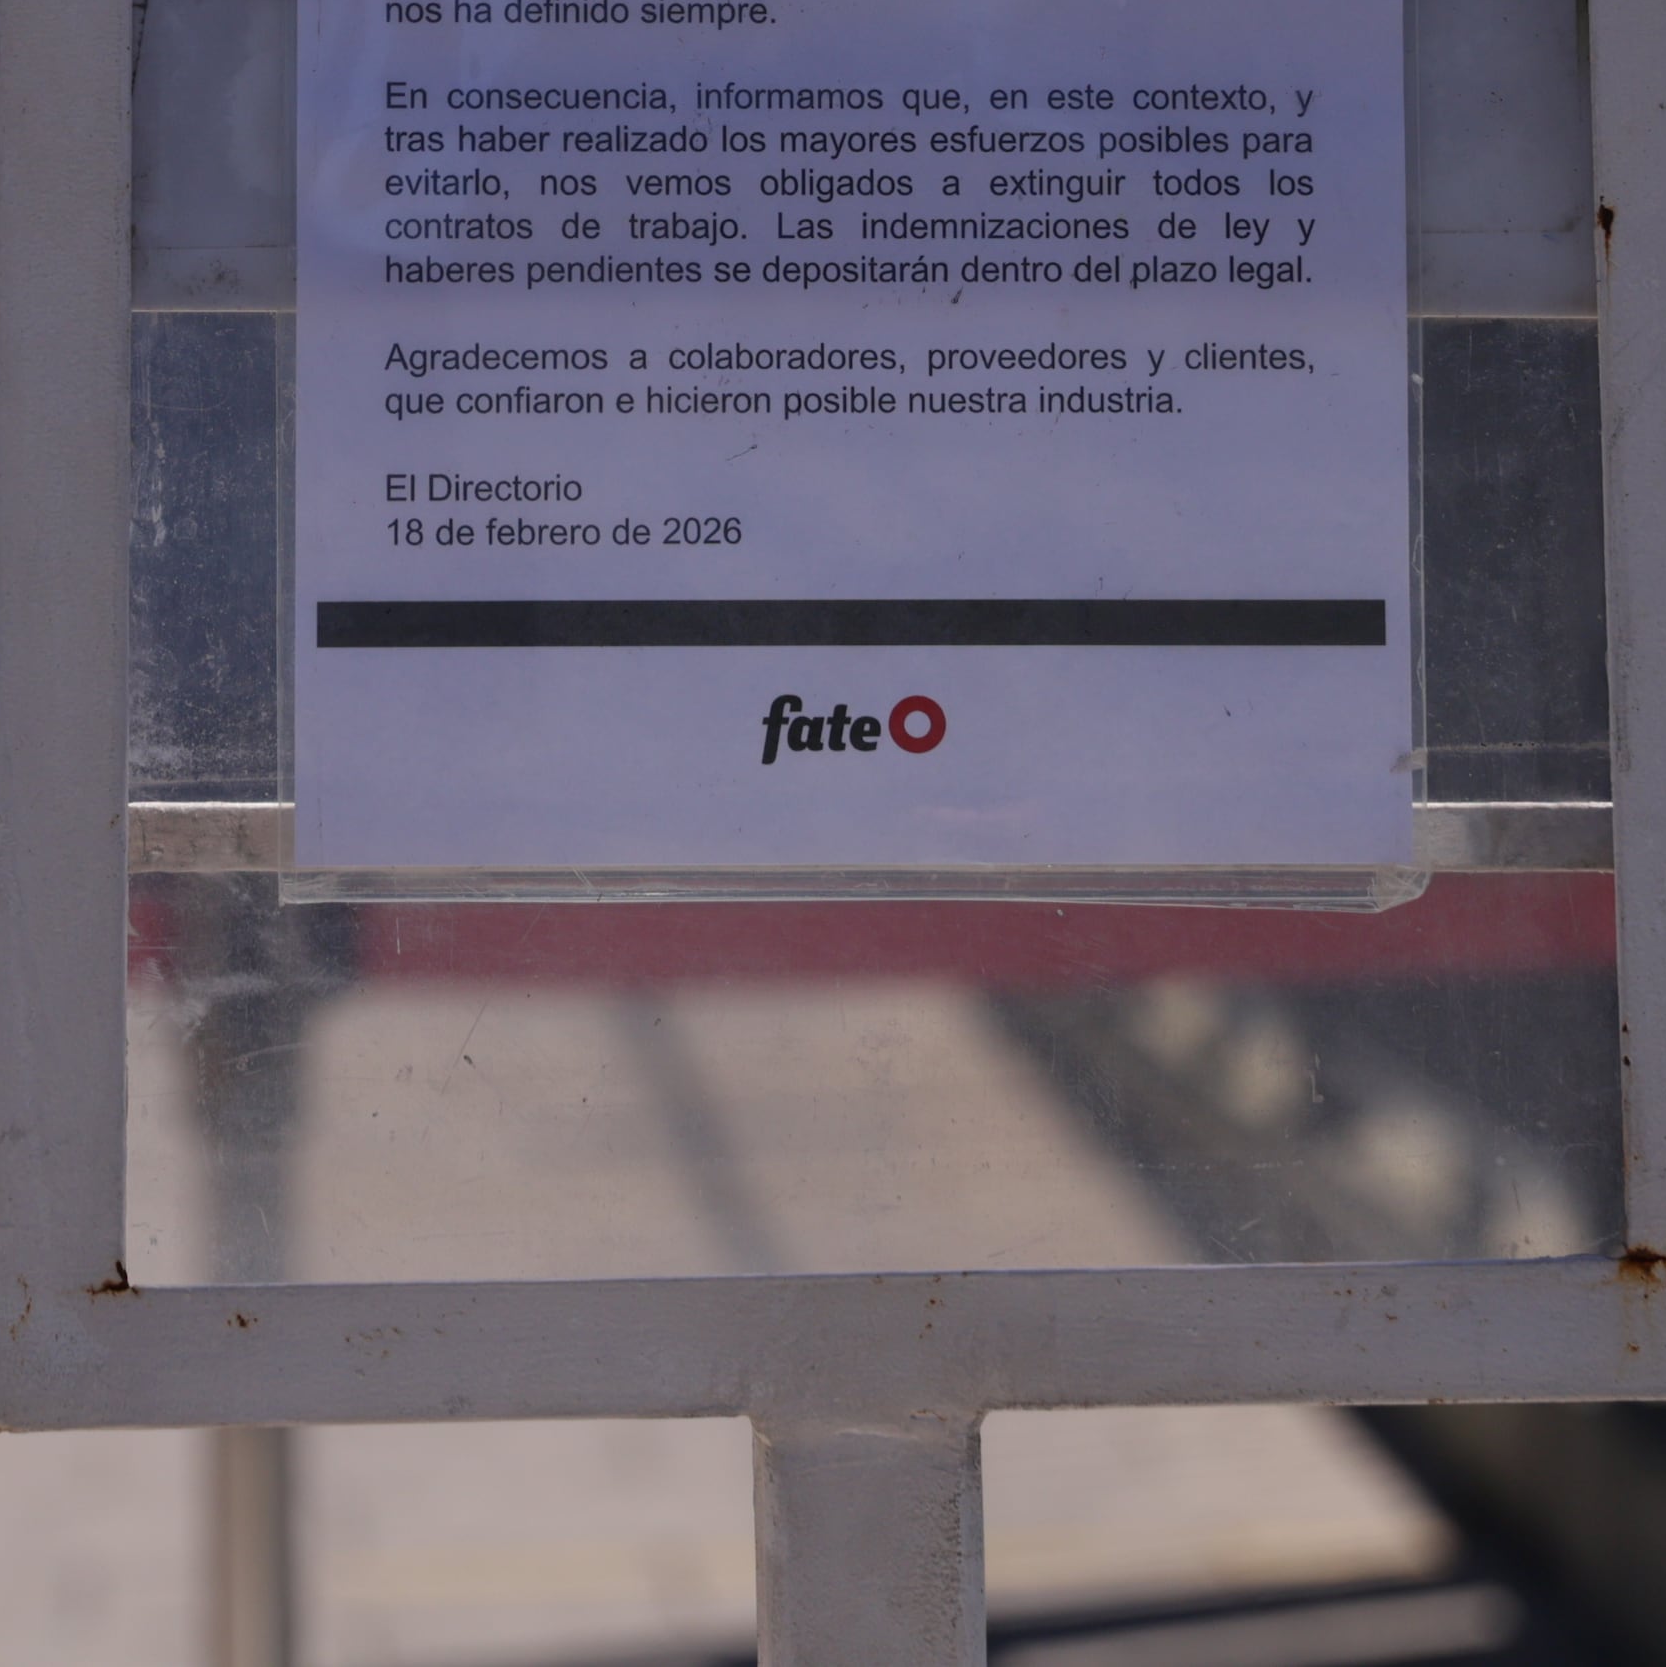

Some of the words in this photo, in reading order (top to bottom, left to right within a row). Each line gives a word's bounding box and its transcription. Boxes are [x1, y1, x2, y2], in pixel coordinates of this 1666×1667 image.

[385, 1, 443, 24] nos
[385, 80, 428, 110] En
[446, 81, 676, 114] consecuencia,
[696, 81, 884, 110] informamos
[901, 88, 970, 117] que,
[989, 88, 1028, 111] en
[1046, 83, 1115, 111] este
[1132, 83, 1276, 115] contexto,
[1294, 89, 1314, 118] y
[383, 125, 445, 153] tras
[458, 124, 551, 153] haber
[562, 124, 709, 153] realizado
[721, 124, 767, 153] los
[780, 131, 917, 161] mayores
[929, 124, 1086, 154] esfuerzos
[1099, 125, 1230, 160] posibles
[1242, 132, 1313, 161] para
[384, 167, 510, 201] evitarlo,
[540, 174, 598, 197] nos
[625, 174, 732, 197] vemos
[759, 167, 914, 204] obligados
[941, 174, 961, 197] a
[989, 167, 1127, 204] extinguir
[1152, 167, 1241, 197] todos
[1269, 168, 1314, 197] los
[384, 213, 534, 240] contratos
[561, 211, 601, 240] de
[628, 211, 747, 247] trabajo.
[777, 211, 834, 240] Las
[861, 211, 1130, 240] indemnizaciones
[1157, 211, 1197, 240] de
[1225, 211, 1271, 247] ley
[1296, 218, 1316, 247] y
[385, 254, 515, 284] haberes
[526, 254, 703, 291] pendientes
[713, 261, 752, 284] se
[762, 254, 949, 291] depositarán
[960, 254, 1063, 284] dentro
[1071, 254, 1121, 284] del
[1129, 254, 1218, 291] plazo
[1228, 254, 1312, 291] legal.
[383, 342, 609, 379] Agradecemos
[628, 348, 648, 371] a
[668, 341, 906, 375] colaboradores,
[927, 341, 1128, 378] proveedores
[1146, 349, 1166, 378] y
[1184, 341, 1315, 375] clientes,
[384, 392, 445, 422] que
[455, 385, 604, 415] confiaron
[615, 392, 635, 415] e
[646, 384, 771, 415] hicieron
[783, 385, 897, 421] posible
[908, 386, 1027, 414] nuestra
[1039, 385, 1183, 414] industria.
[385, 473, 416, 503] El
[428, 473, 583, 503] Directorio
[387, 517, 424, 547] 18
[435, 517, 475, 547] de
[485, 516, 601, 547] febrero
[611, 517, 652, 546] de
[661, 516, 743, 546] 2026
